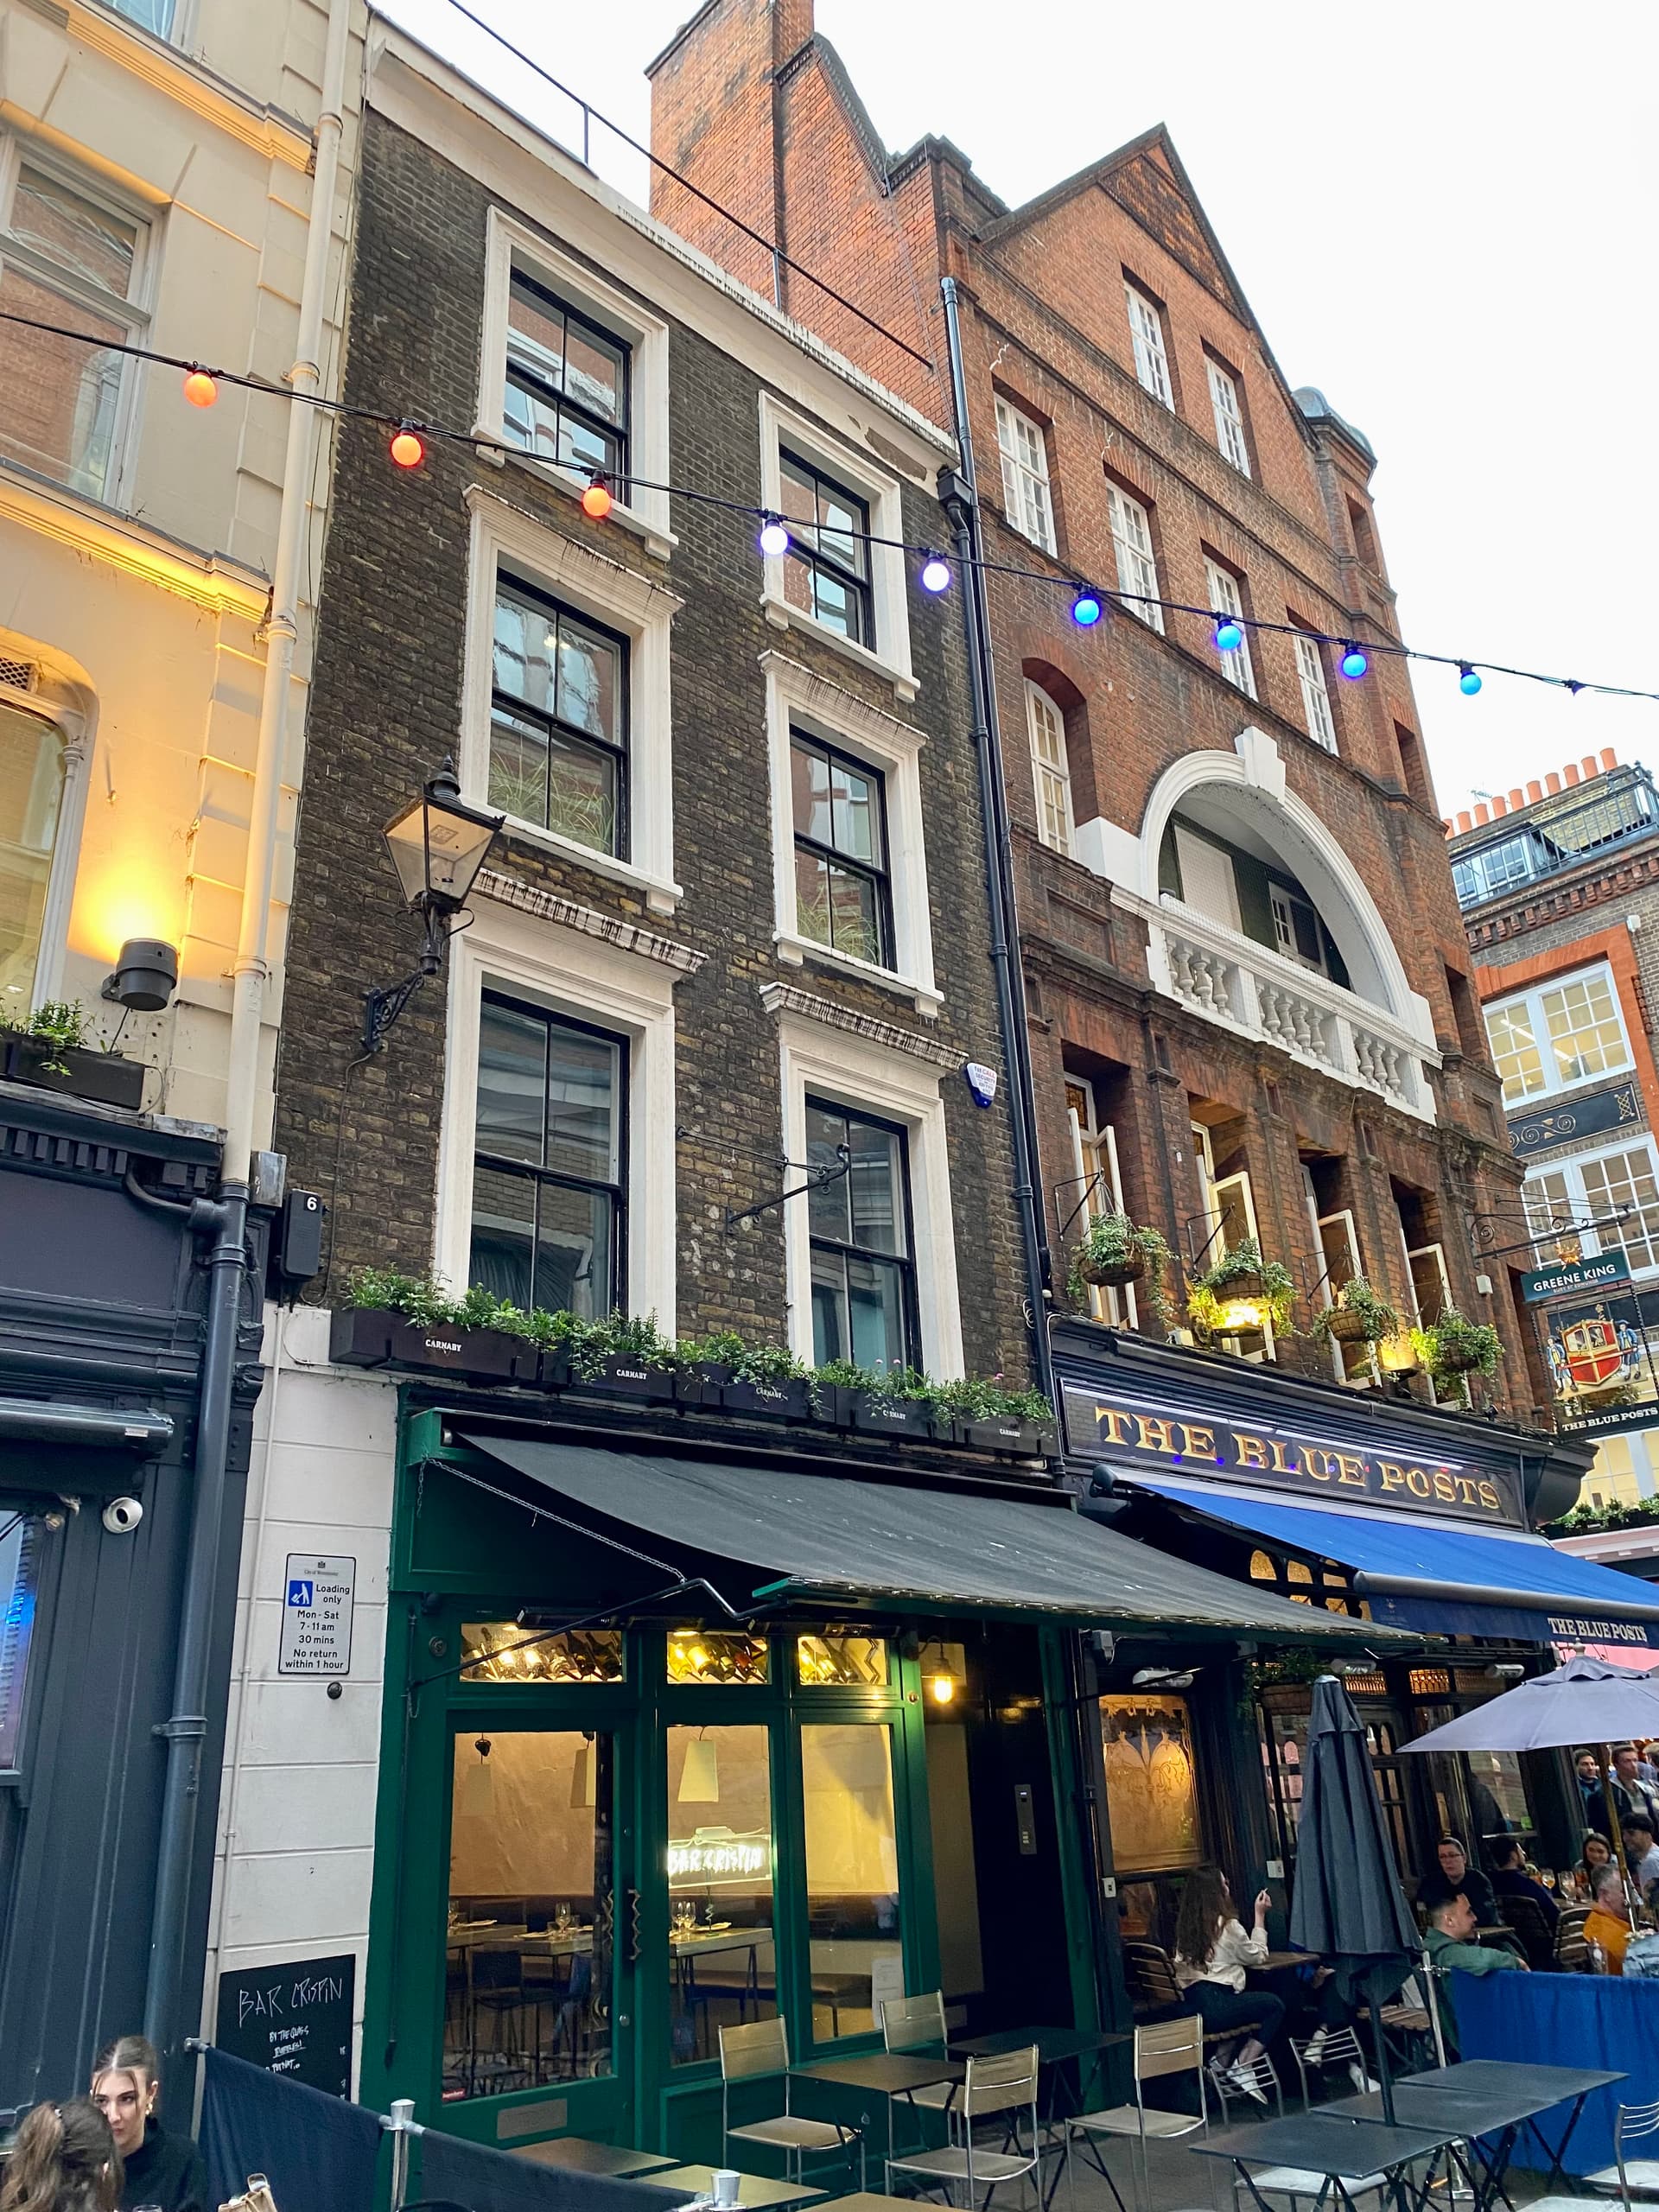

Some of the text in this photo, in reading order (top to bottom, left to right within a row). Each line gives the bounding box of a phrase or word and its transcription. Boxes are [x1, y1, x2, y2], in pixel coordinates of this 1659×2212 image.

[307, 1197, 318, 1211] 6
[1534, 1264, 1617, 1292] GREENE KING
[425, 1338, 462, 1352] CARNABY
[616, 1369, 647, 1381] CARNABY
[1561, 1407, 1659, 1432] THE BLUE POSTS
[1095, 1407, 1501, 1510] THE BLUE POSTS
[316, 1584, 350, 1595] Loading
[323, 1595, 342, 1605] only
[297, 1610, 316, 1618] Mon
[324, 1611, 340, 1619] Sat
[1547, 1617, 1648, 1643] THE BLUE POSTS
[298, 1635, 334, 1644] 30 mins
[294, 1649, 338, 1658] No return
[285, 1659, 344, 1669] within 1 hour
[239, 1985, 283, 2028] BAR
